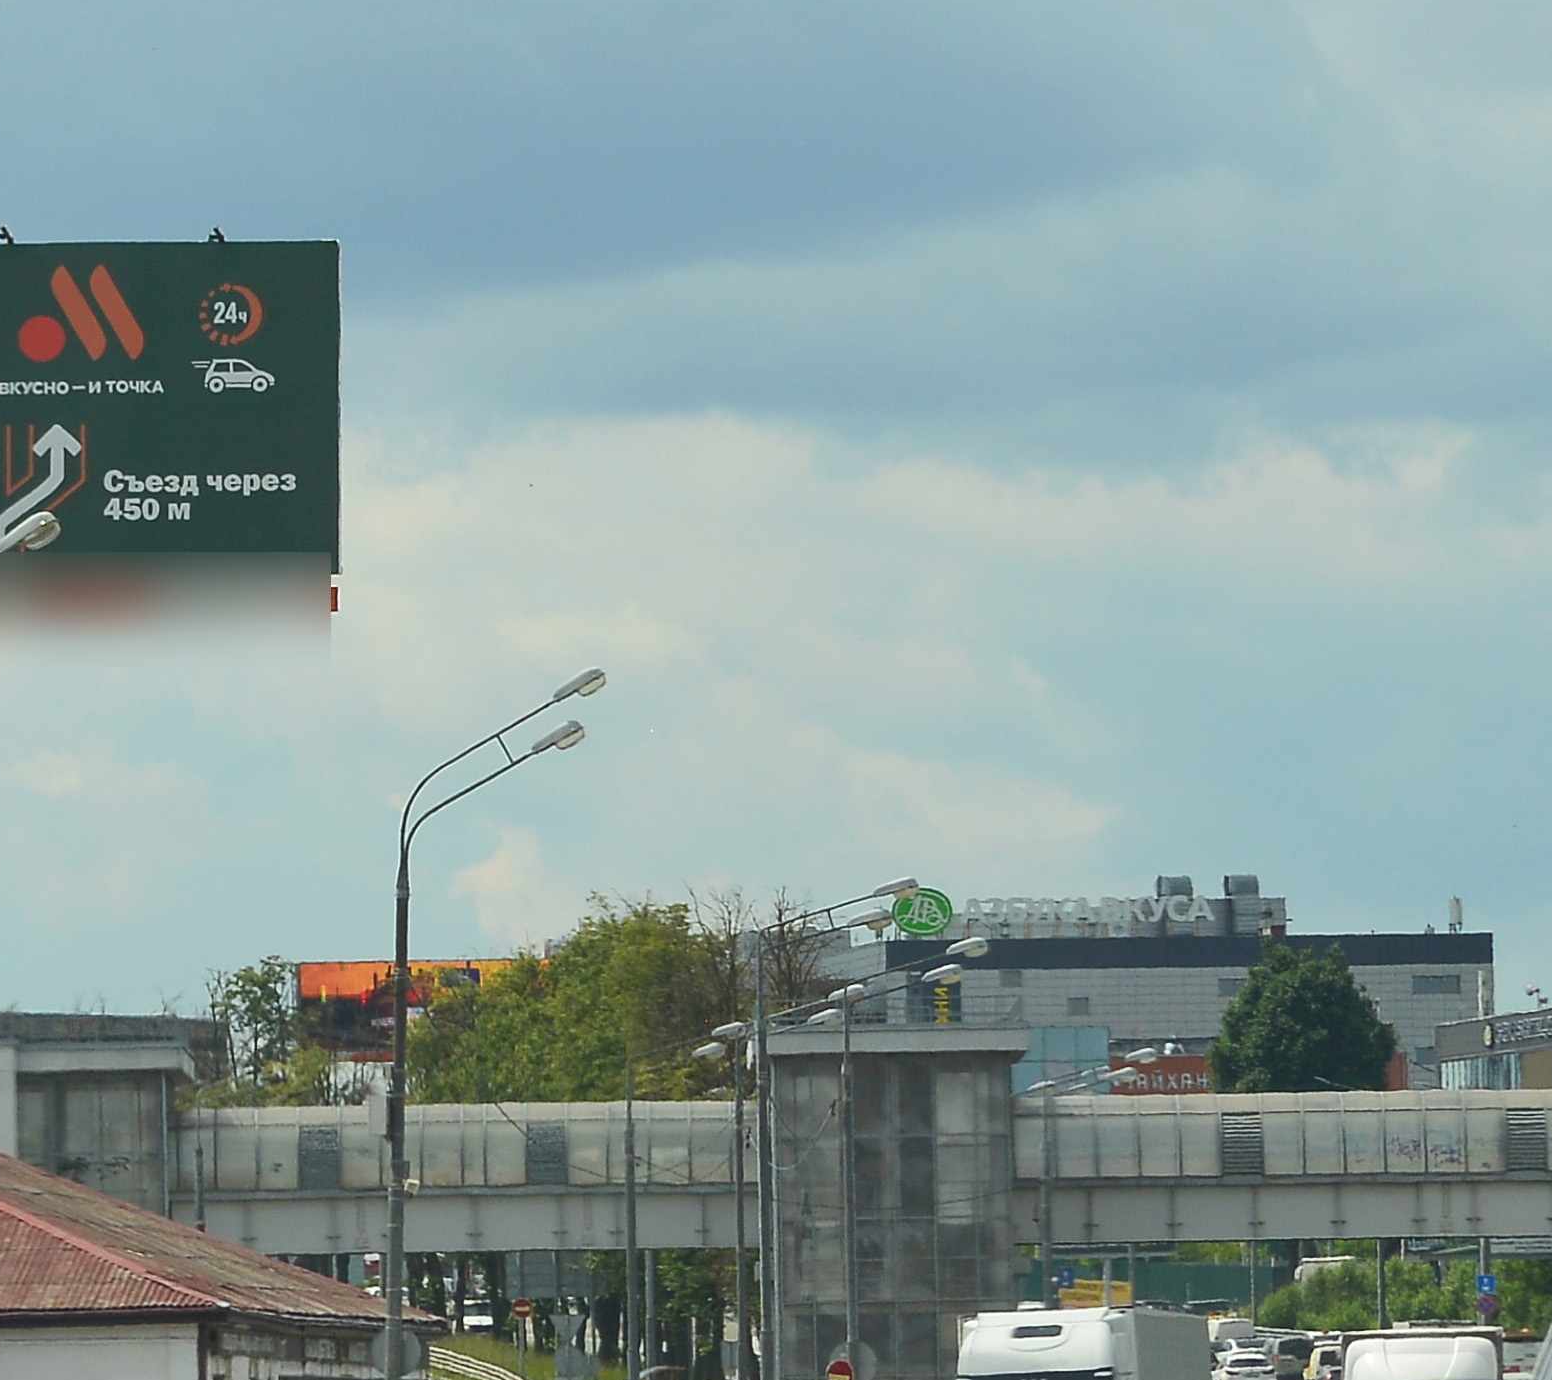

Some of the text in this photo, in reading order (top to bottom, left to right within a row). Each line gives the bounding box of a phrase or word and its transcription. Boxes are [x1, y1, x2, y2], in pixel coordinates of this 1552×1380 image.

[107, 379, 165, 395] ТОЧКА
[103, 470, 297, 497] Съезд через
[103, 498, 191, 521] 450 м
